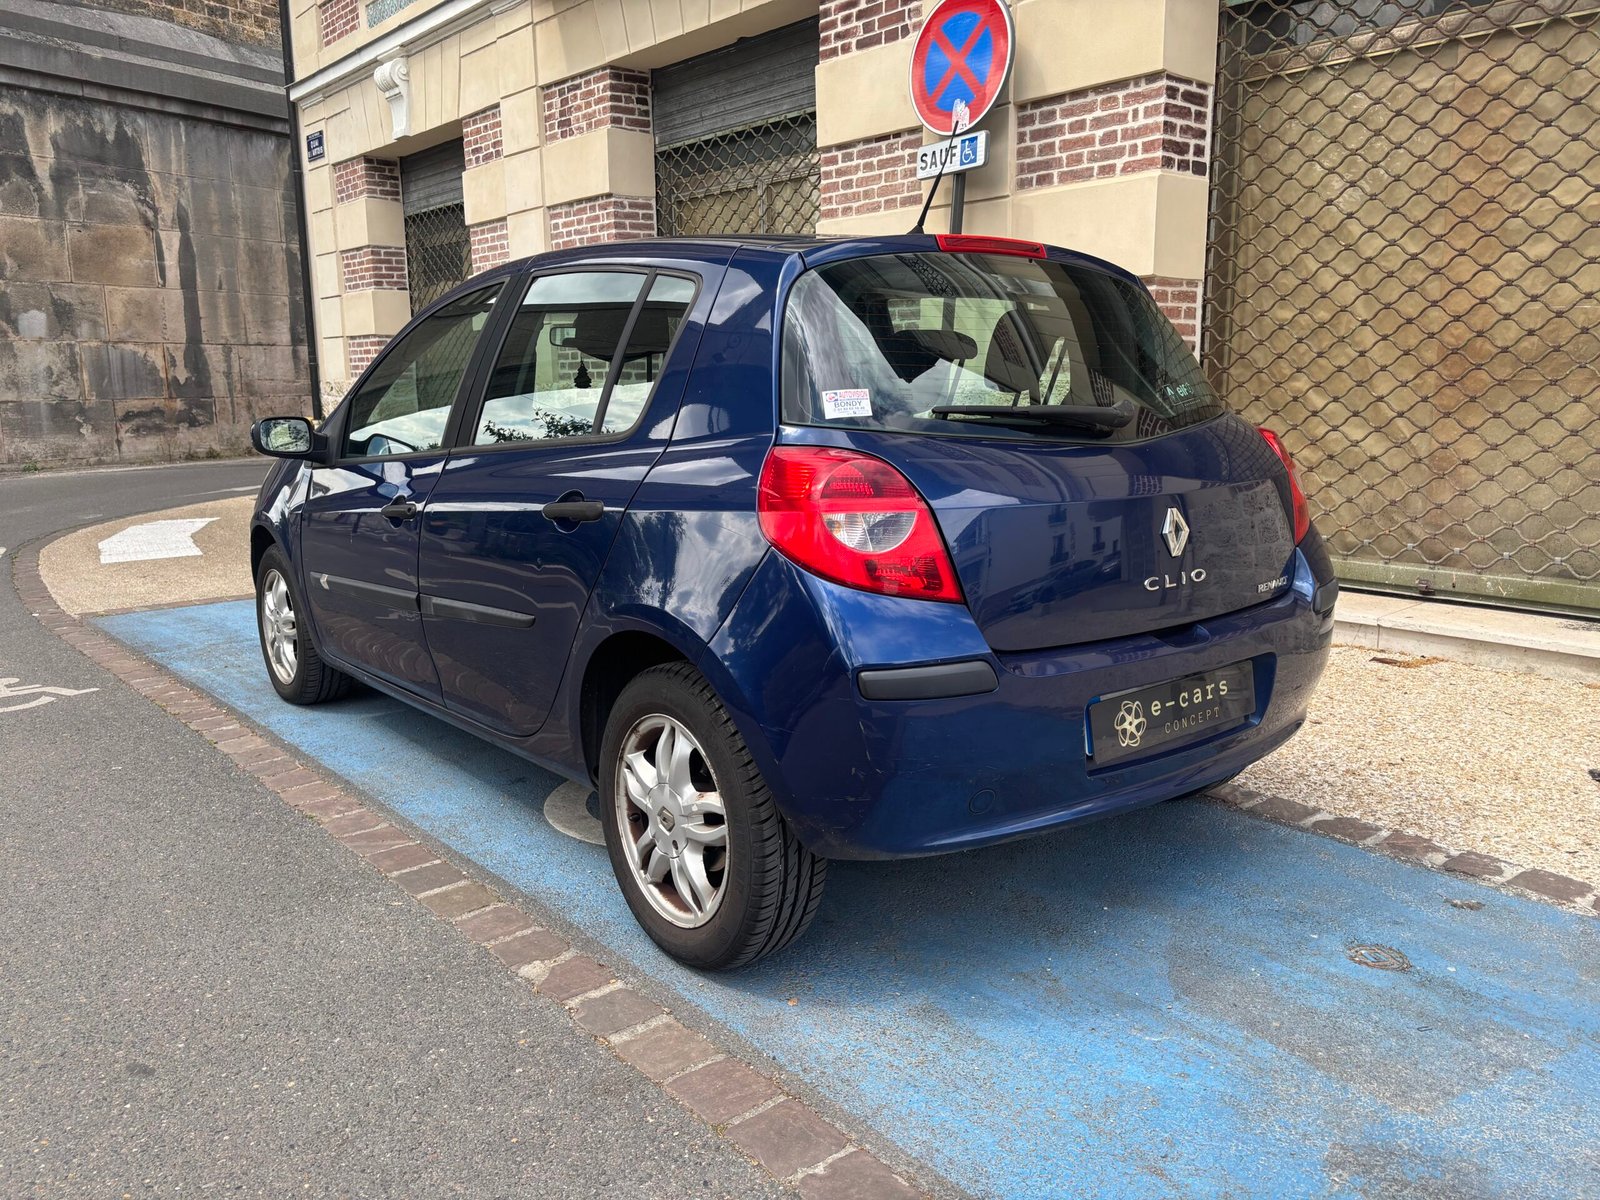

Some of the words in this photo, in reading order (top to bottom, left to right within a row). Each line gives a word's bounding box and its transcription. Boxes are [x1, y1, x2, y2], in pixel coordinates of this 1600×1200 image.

[920, 145, 957, 171] SAUF
[834, 400, 862, 408] BONDY
[1144, 568, 1207, 591] CLIO
[1151, 680, 1228, 716] e-cars
[1164, 706, 1220, 734] CONCEPT
